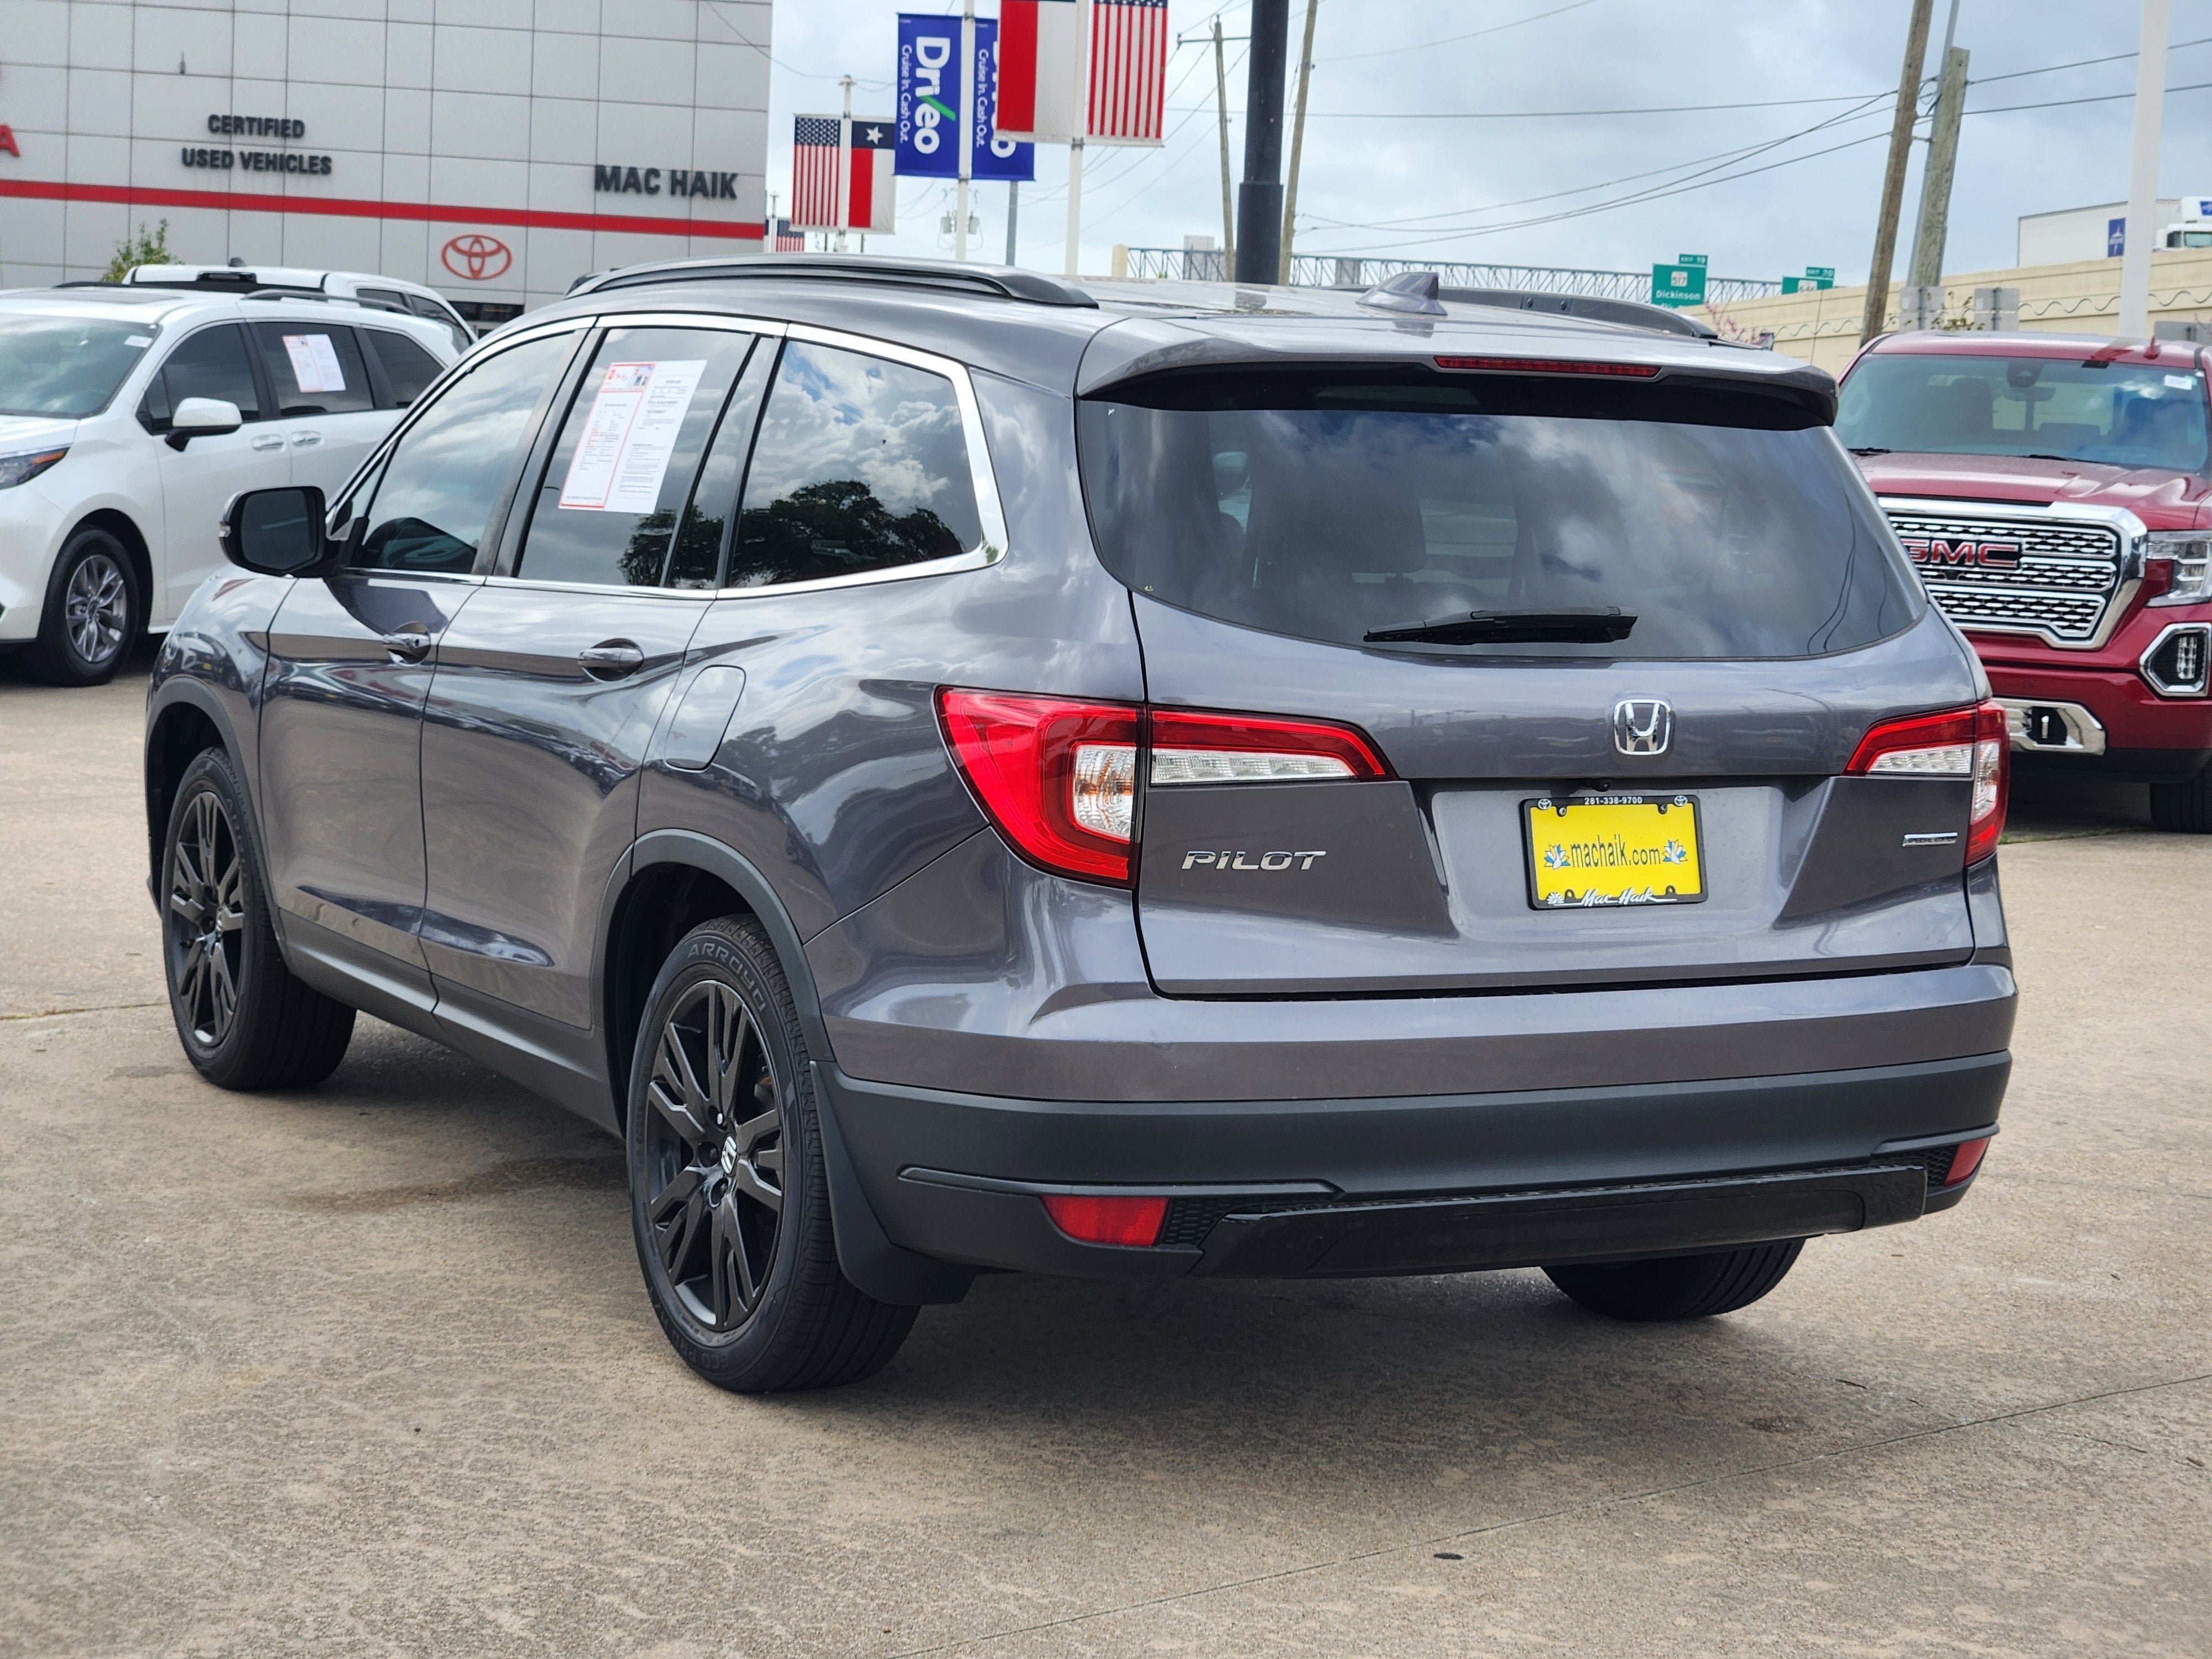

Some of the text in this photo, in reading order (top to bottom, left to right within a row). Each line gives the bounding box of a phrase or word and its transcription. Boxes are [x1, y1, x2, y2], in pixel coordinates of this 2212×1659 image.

[901, 44, 912, 78] Cruise
[978, 48, 989, 82] Cruise
[901, 79, 911, 91] In
[914, 36, 956, 154] Driveo
[978, 83, 988, 96] In
[900, 92, 911, 119] Cash
[977, 96, 988, 123] Cash
[207, 114, 305, 139] CERTIFIED
[181, 147, 333, 175] USED VEHICLES
[594, 164, 739, 200] MAC HAIK
[1656, 289, 1700, 300] Dickinson
[1584, 796, 1642, 805] 281-338-9700
[1181, 851, 1327, 870] PILOT
[1571, 833, 1661, 868] machaik.com
[1579, 886, 1659, 907] Mac Haik
[687, 942, 766, 1013] ARROYO
